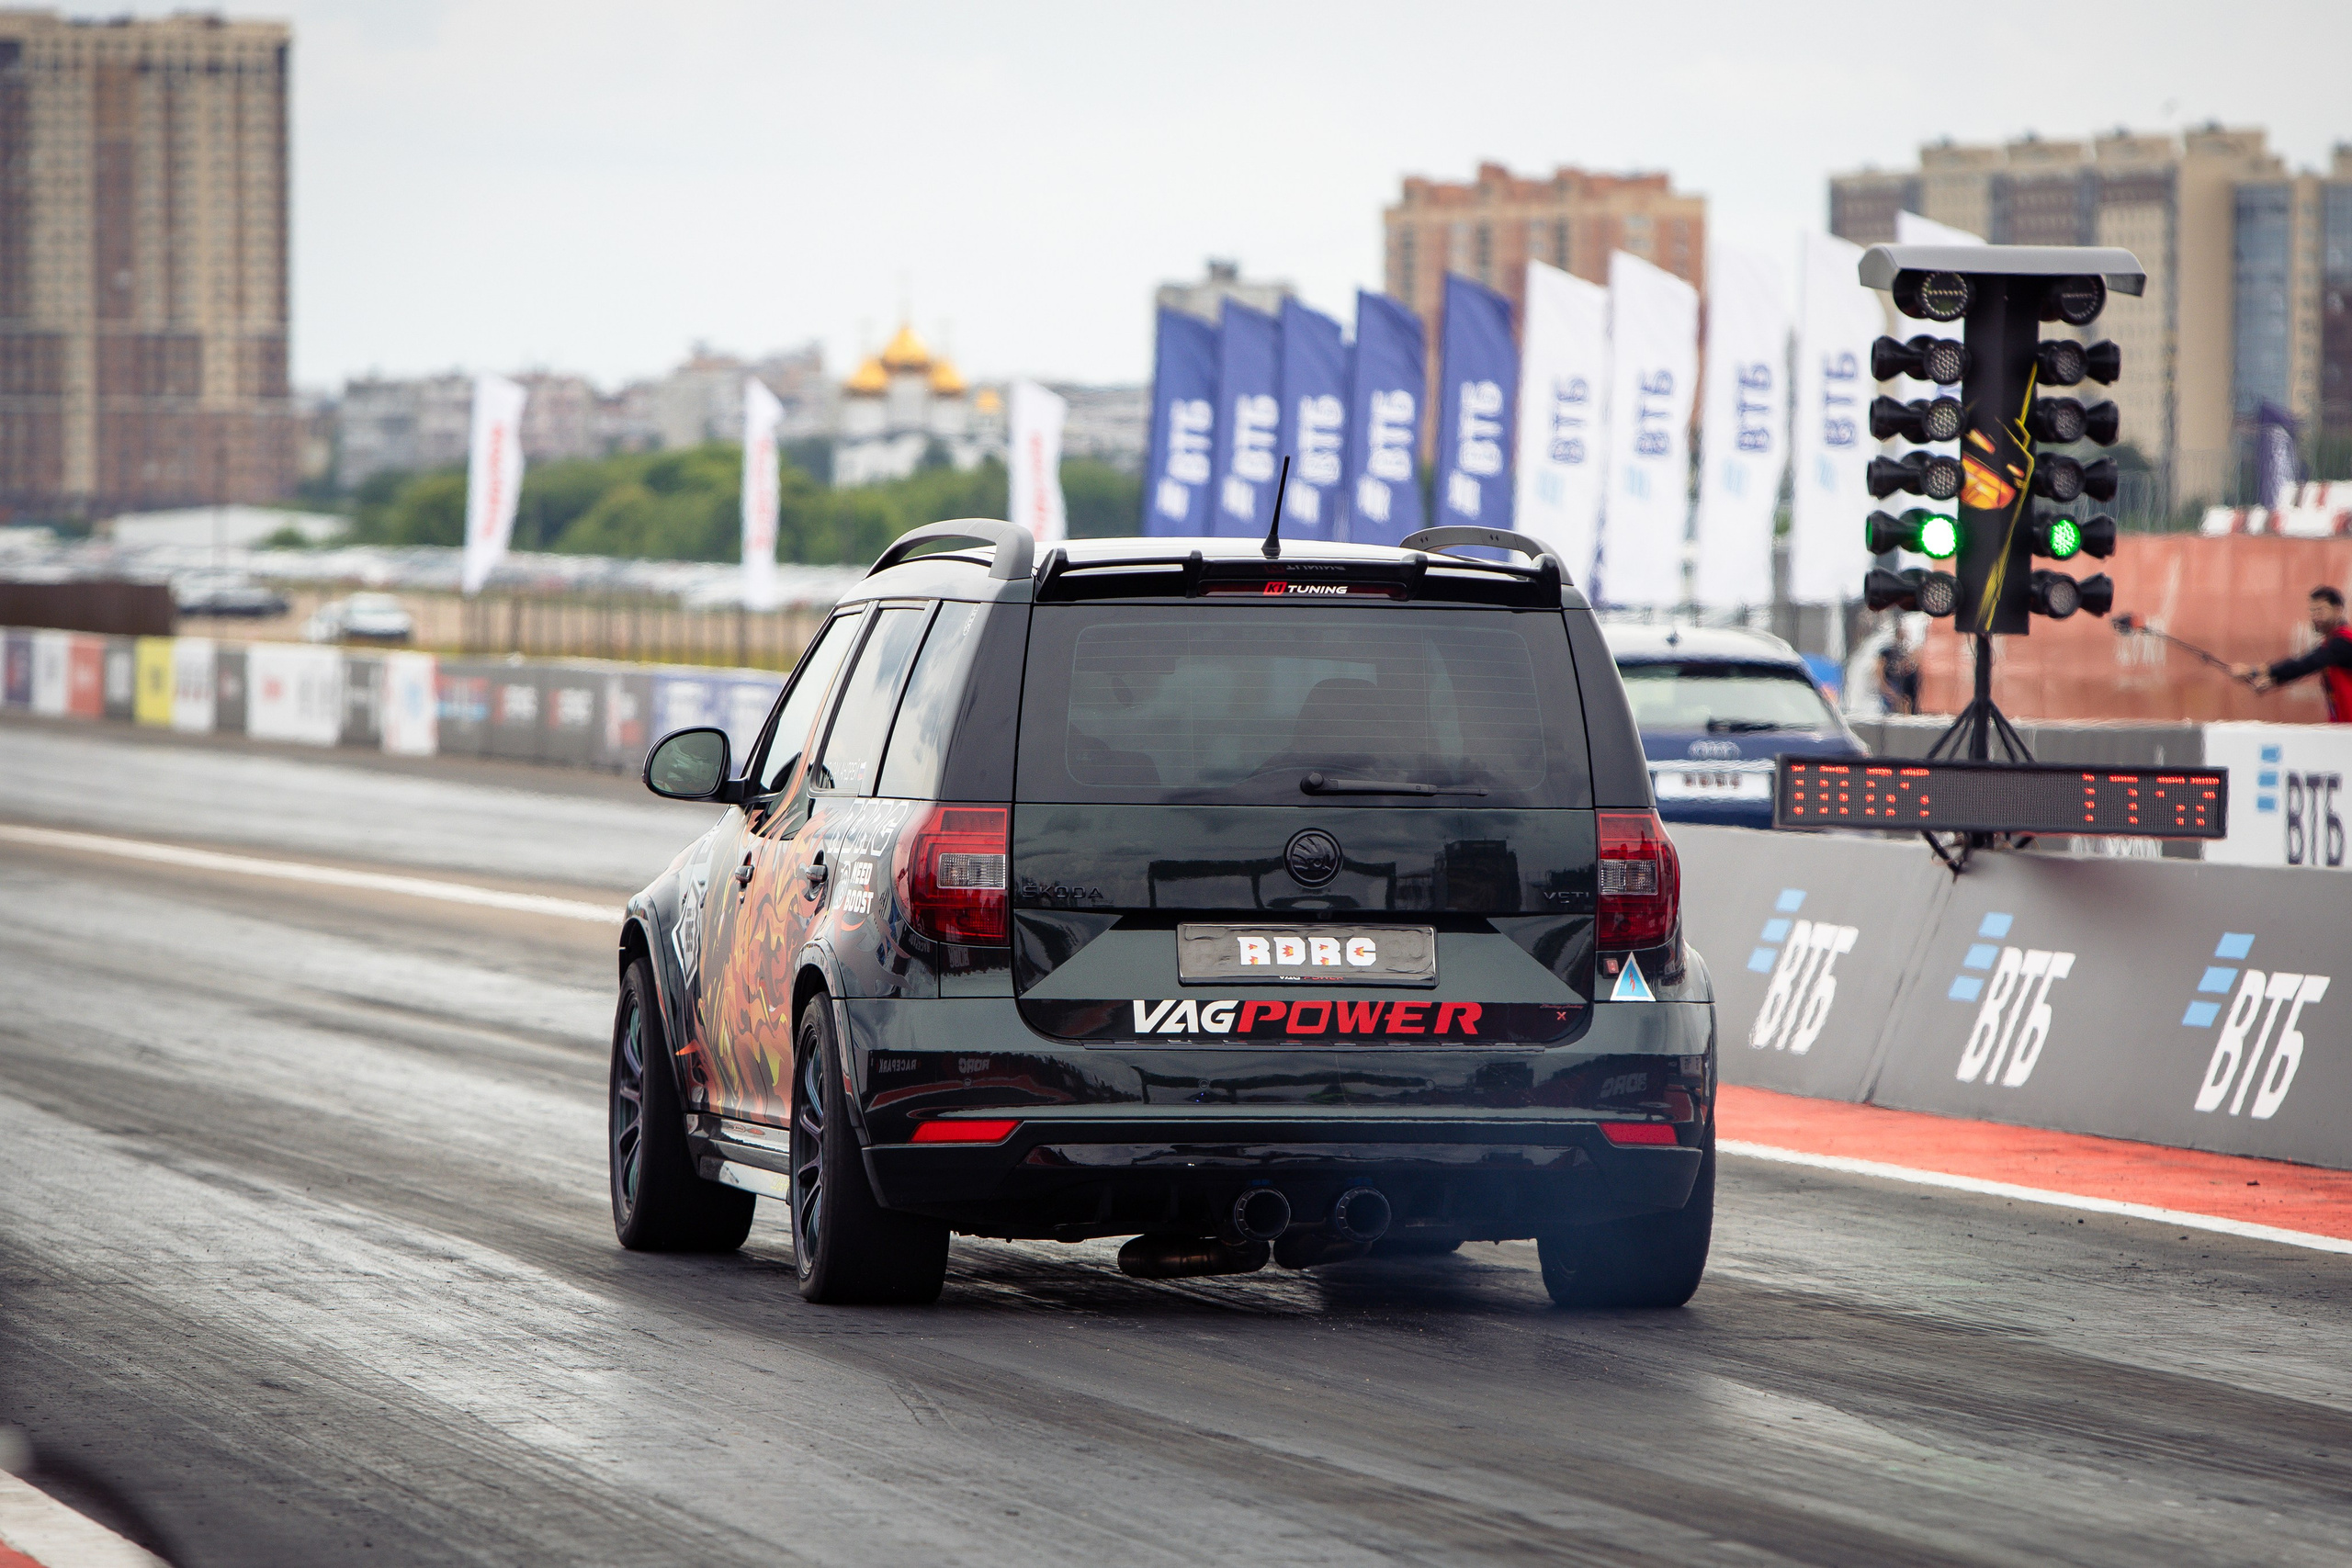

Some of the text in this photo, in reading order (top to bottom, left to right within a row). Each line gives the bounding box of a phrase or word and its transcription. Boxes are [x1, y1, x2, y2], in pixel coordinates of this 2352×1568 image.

[1458, 379, 1503, 478] ВТБ
[1550, 376, 1588, 464] ВТБ
[1635, 368, 1674, 457] ВТБ
[1736, 363, 1771, 452] ВТБ
[1824, 344, 1856, 446] ВТБ
[1288, 585, 1348, 594] TUNING
[2286, 770, 2345, 866] ВТБ
[843, 889, 875, 914] BOOST
[851, 862, 874, 885] NEED
[1022, 882, 1104, 899] ŠKODA
[1237, 937, 1376, 965] RDRC
[1749, 919, 1860, 1055] ВТБ
[1956, 946, 2076, 1088] ВТБ
[2194, 969, 2331, 1120] ВТБ
